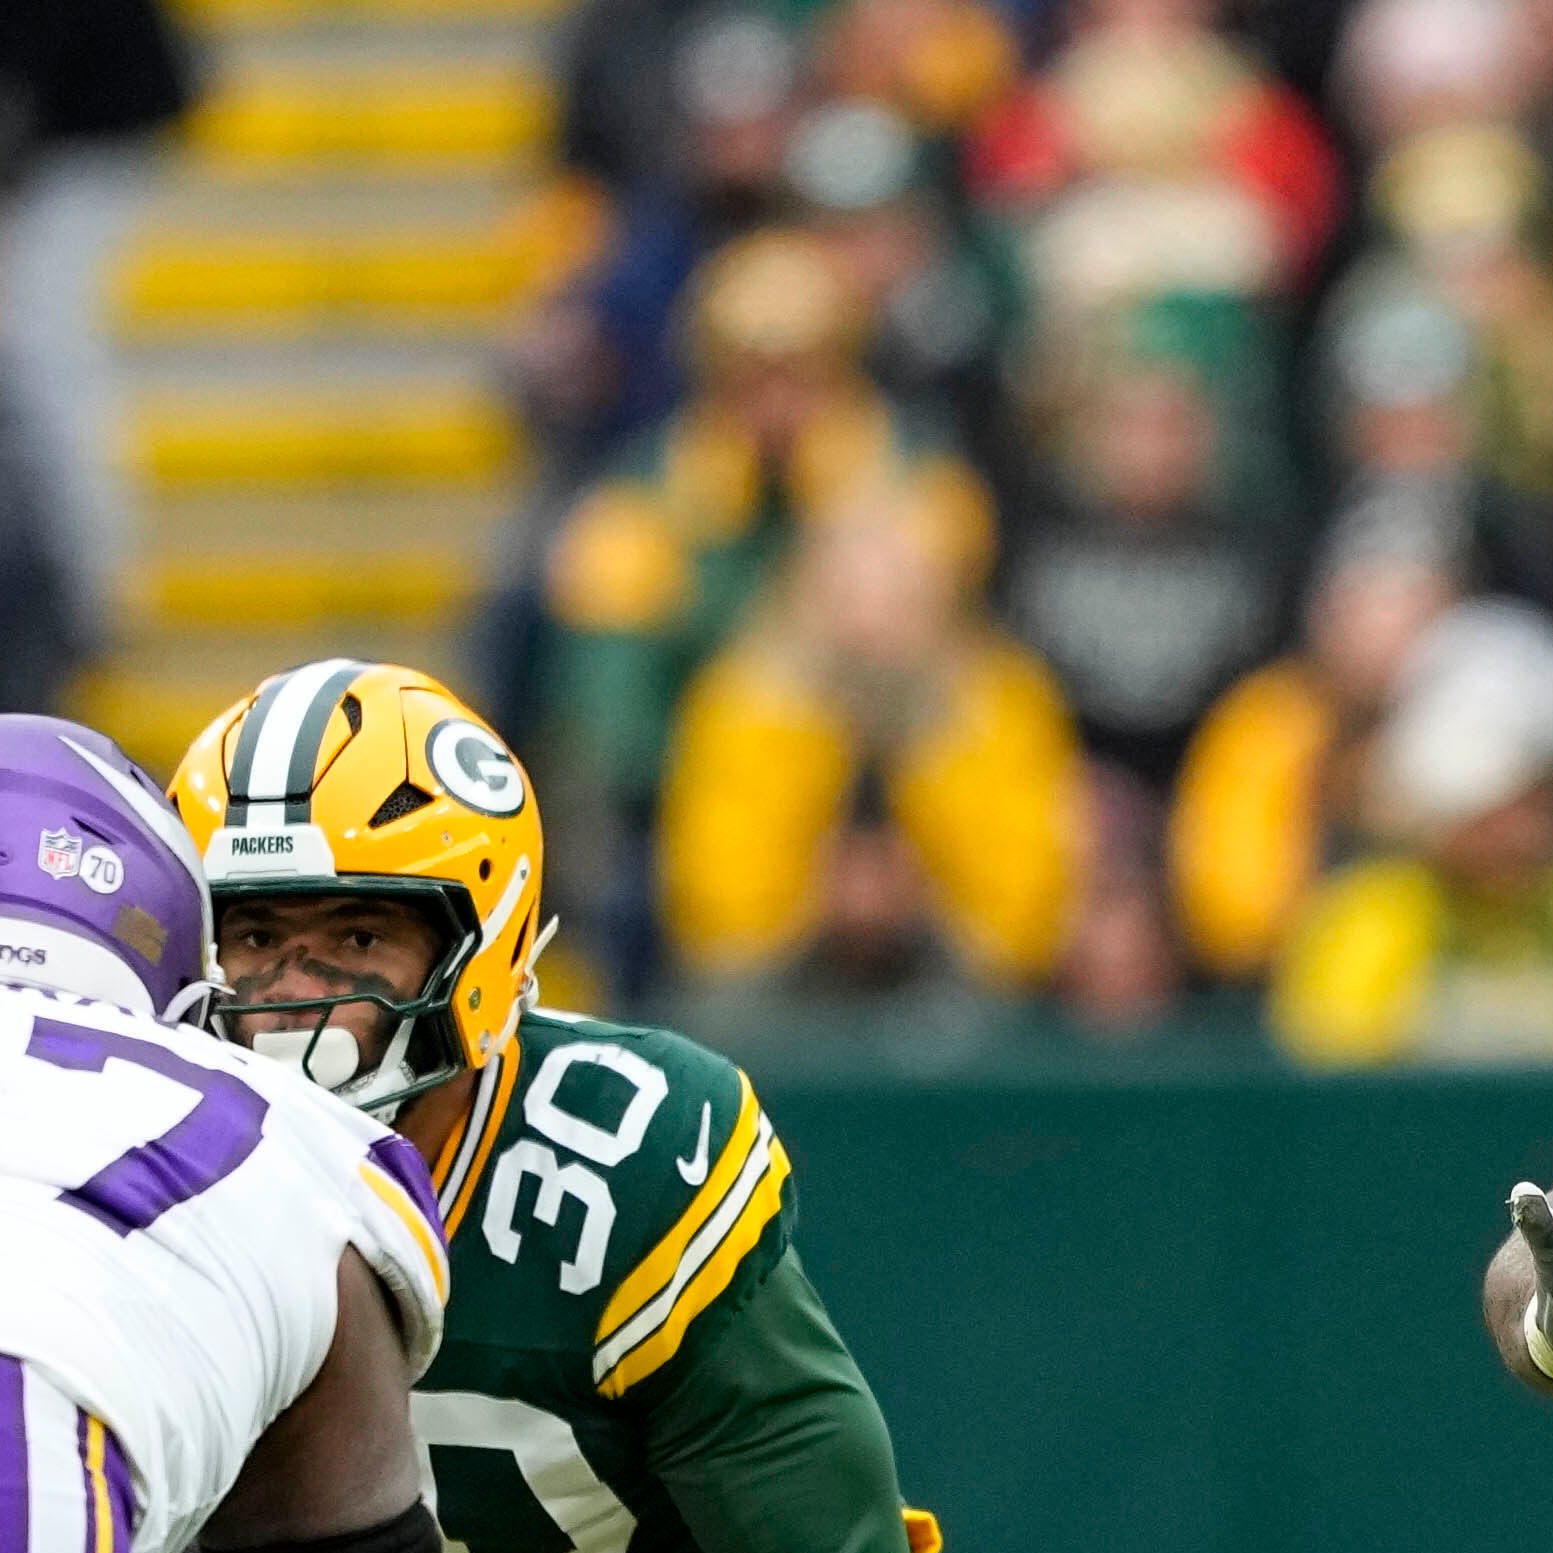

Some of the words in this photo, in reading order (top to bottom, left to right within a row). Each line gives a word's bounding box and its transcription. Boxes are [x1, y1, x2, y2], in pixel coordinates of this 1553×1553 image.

[428, 721, 526, 816] G
[90, 854, 117, 884] 70
[232, 836, 294, 856] PACKERS
[482, 1042, 669, 1296] 30
